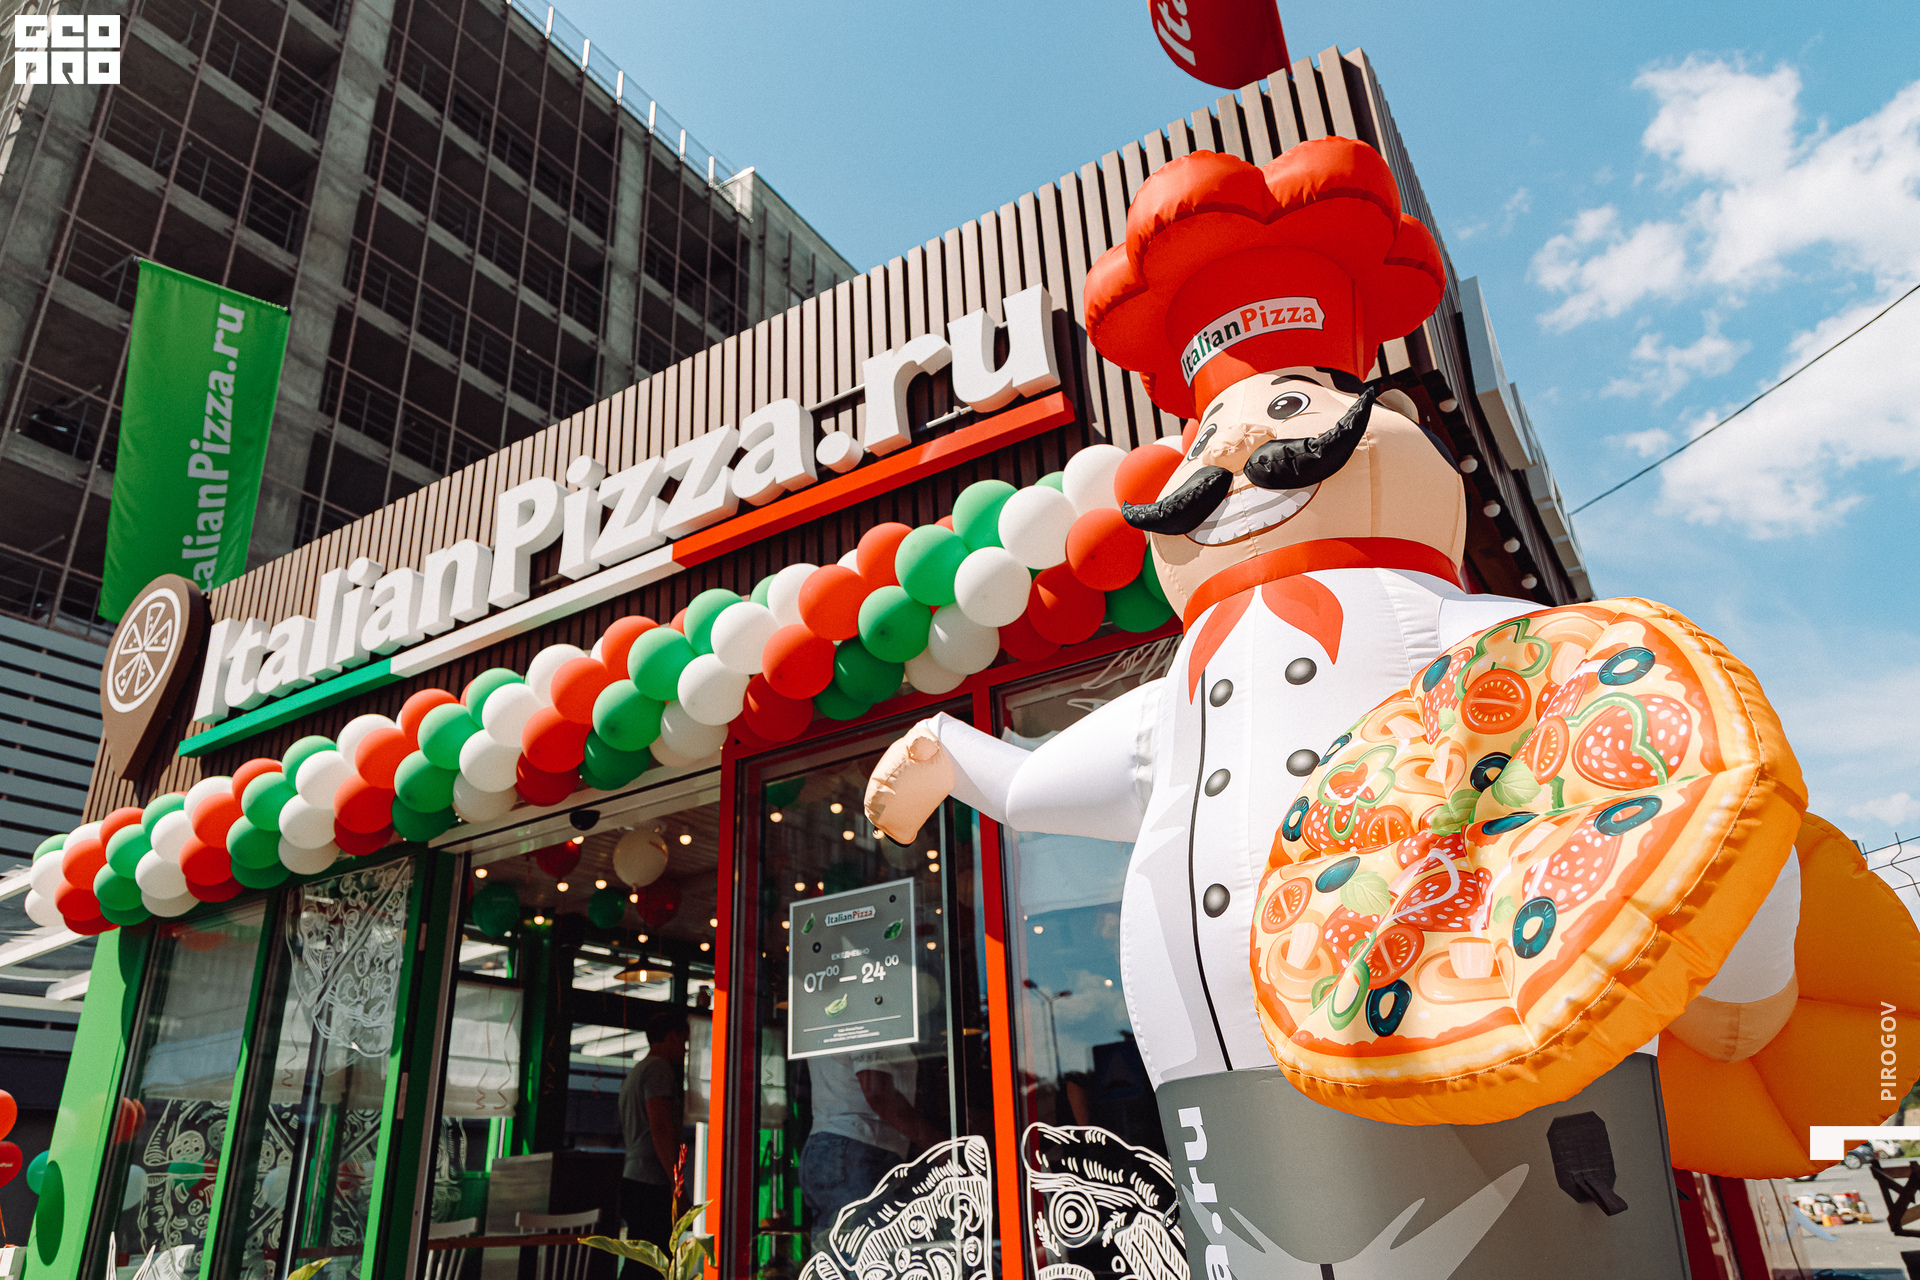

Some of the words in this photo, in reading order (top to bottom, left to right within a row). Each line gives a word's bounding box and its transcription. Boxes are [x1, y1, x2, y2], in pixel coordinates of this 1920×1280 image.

[1181, 304, 1318, 379] ItalianPizza
[193, 283, 1061, 724] ItalianPizza.ru
[827, 909, 874, 924] ItalianPizza
